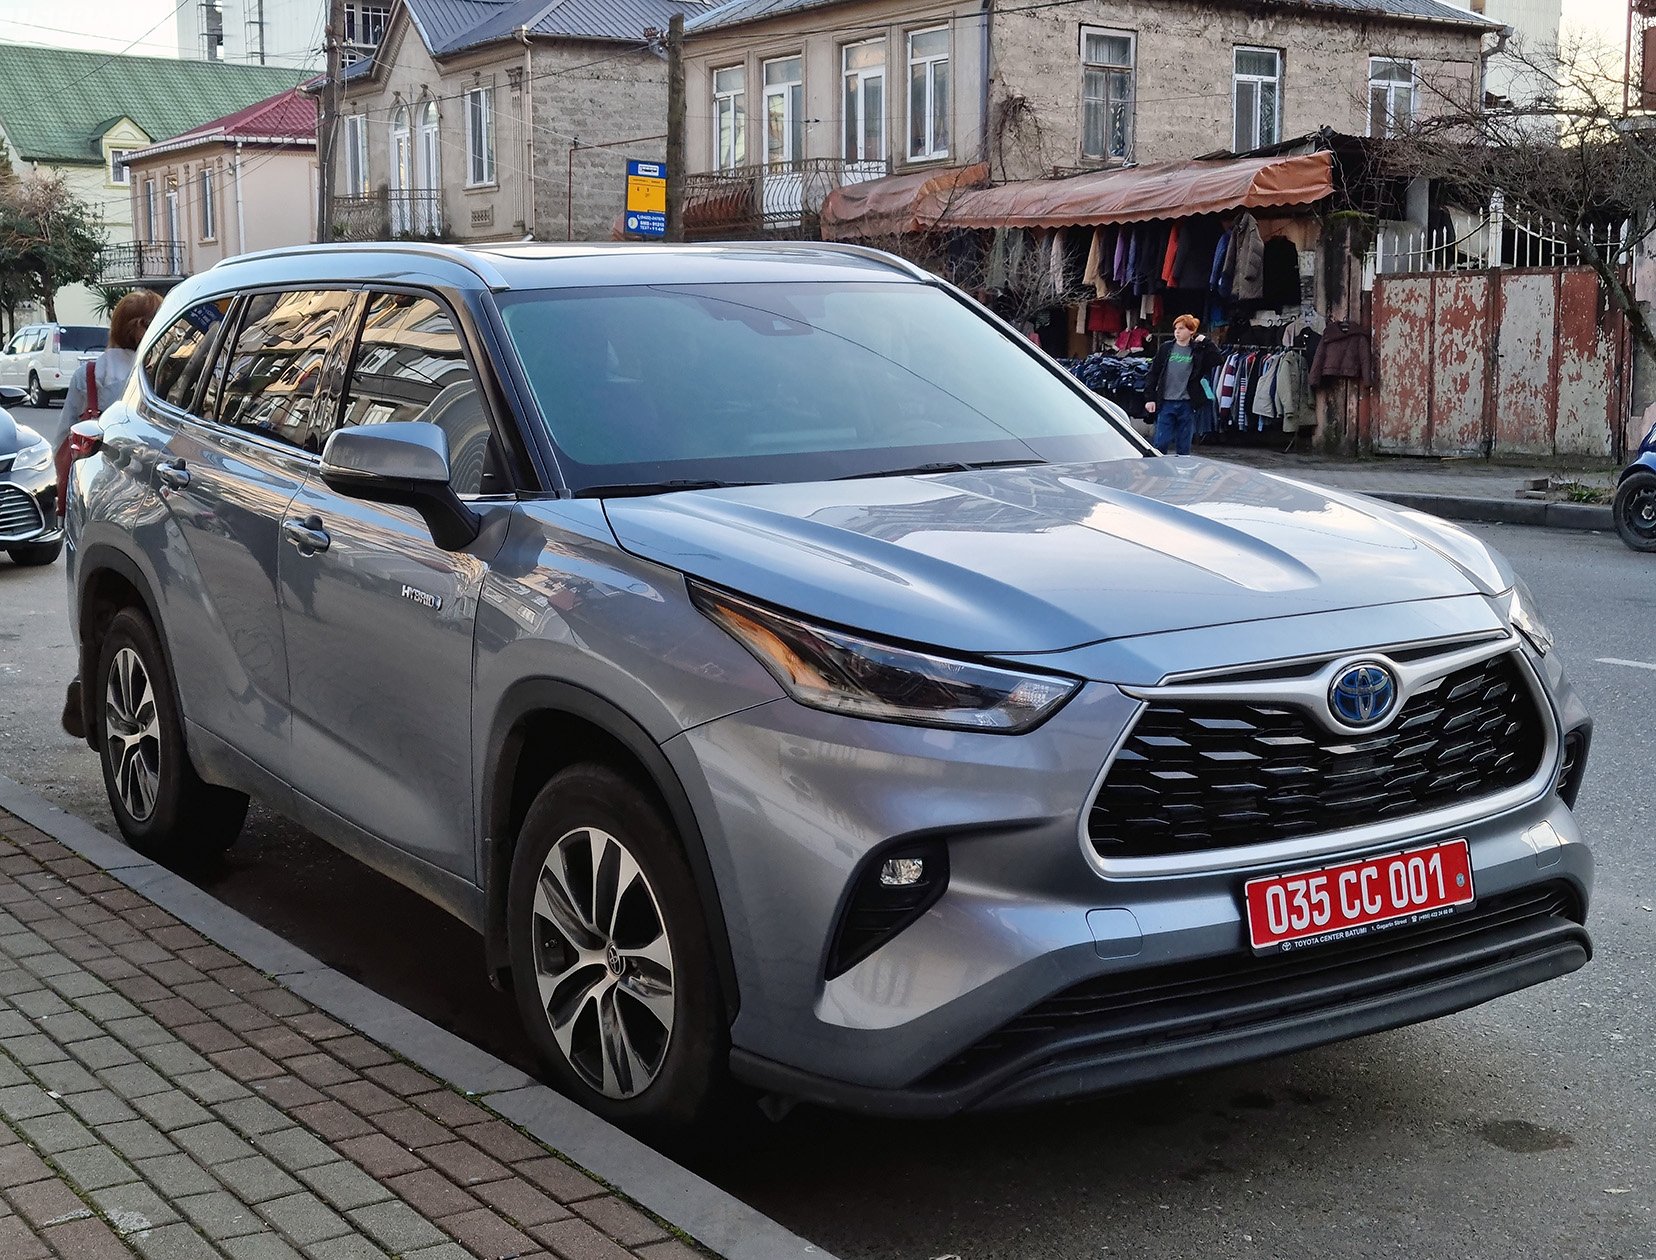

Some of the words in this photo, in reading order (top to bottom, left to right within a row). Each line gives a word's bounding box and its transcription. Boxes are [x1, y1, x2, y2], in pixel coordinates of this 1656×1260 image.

[402, 585, 435, 607] HYBRID
[1265, 876, 1331, 935] 035
[1338, 866, 1382, 919] CC
[1388, 852, 1446, 909] 001
[1294, 938, 1319, 948] TOYOTA
[1320, 932, 1344, 943] CENTER
[1345, 927, 1367, 938] BATUMI
